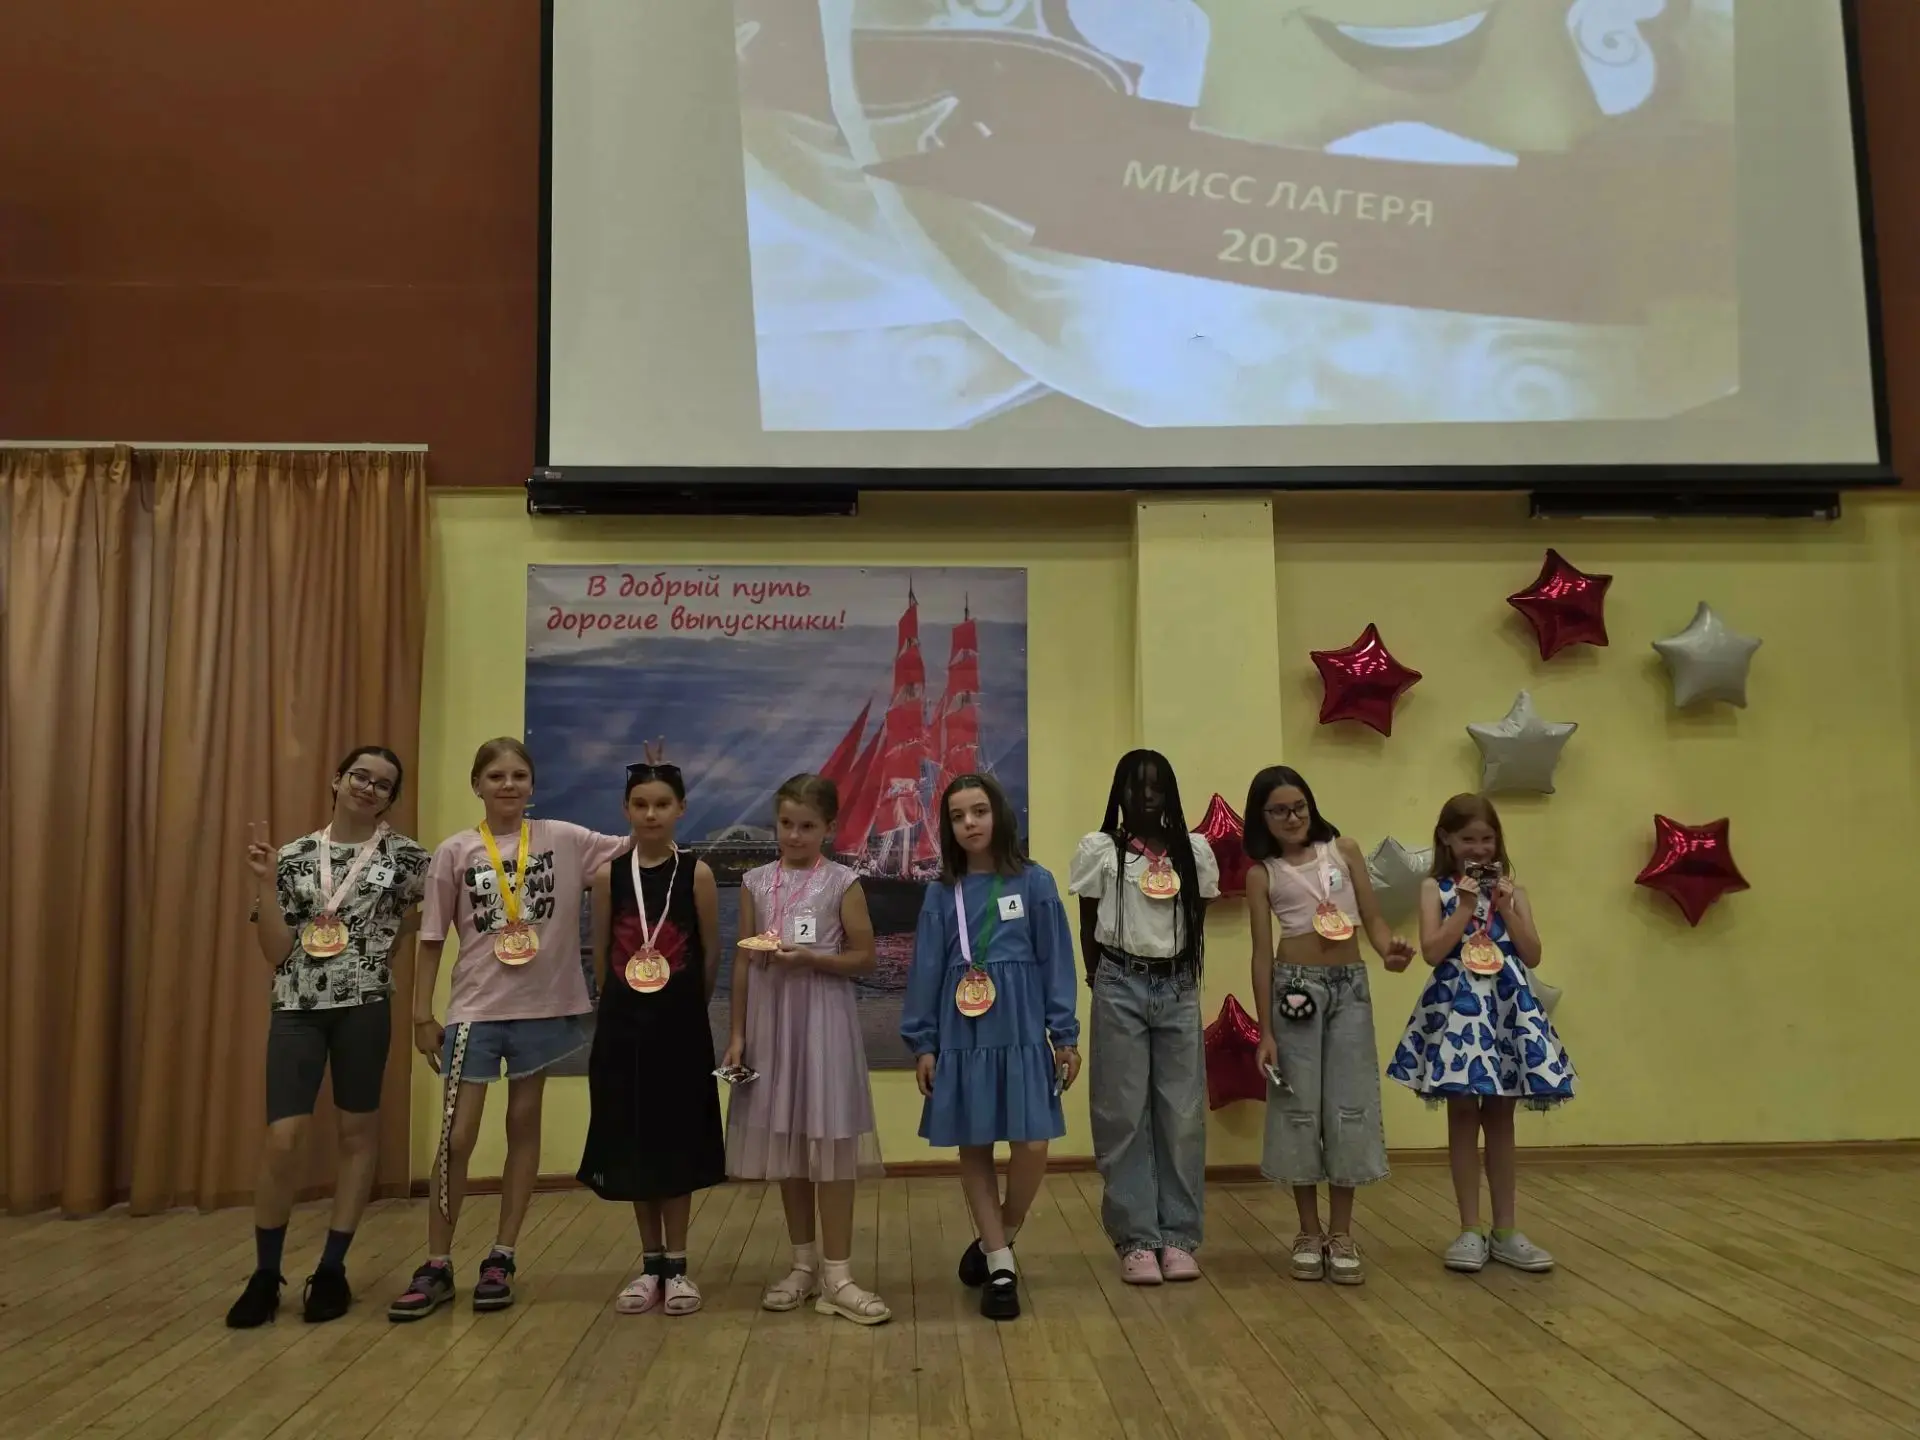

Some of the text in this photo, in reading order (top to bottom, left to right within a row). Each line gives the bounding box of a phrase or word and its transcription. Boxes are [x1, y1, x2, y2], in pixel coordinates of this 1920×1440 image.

[1122, 160, 1433, 227] МИСС ЛАГЕРЯ
[1217, 228, 1339, 275] 2026
[586, 571, 810, 604] В добрый путь
[547, 605, 845, 638] дорогие выпускники!
[376, 871, 386, 881] 5
[482, 878, 491, 890] 6
[1008, 900, 1017, 911] 4
[800, 924, 808, 935] 2
